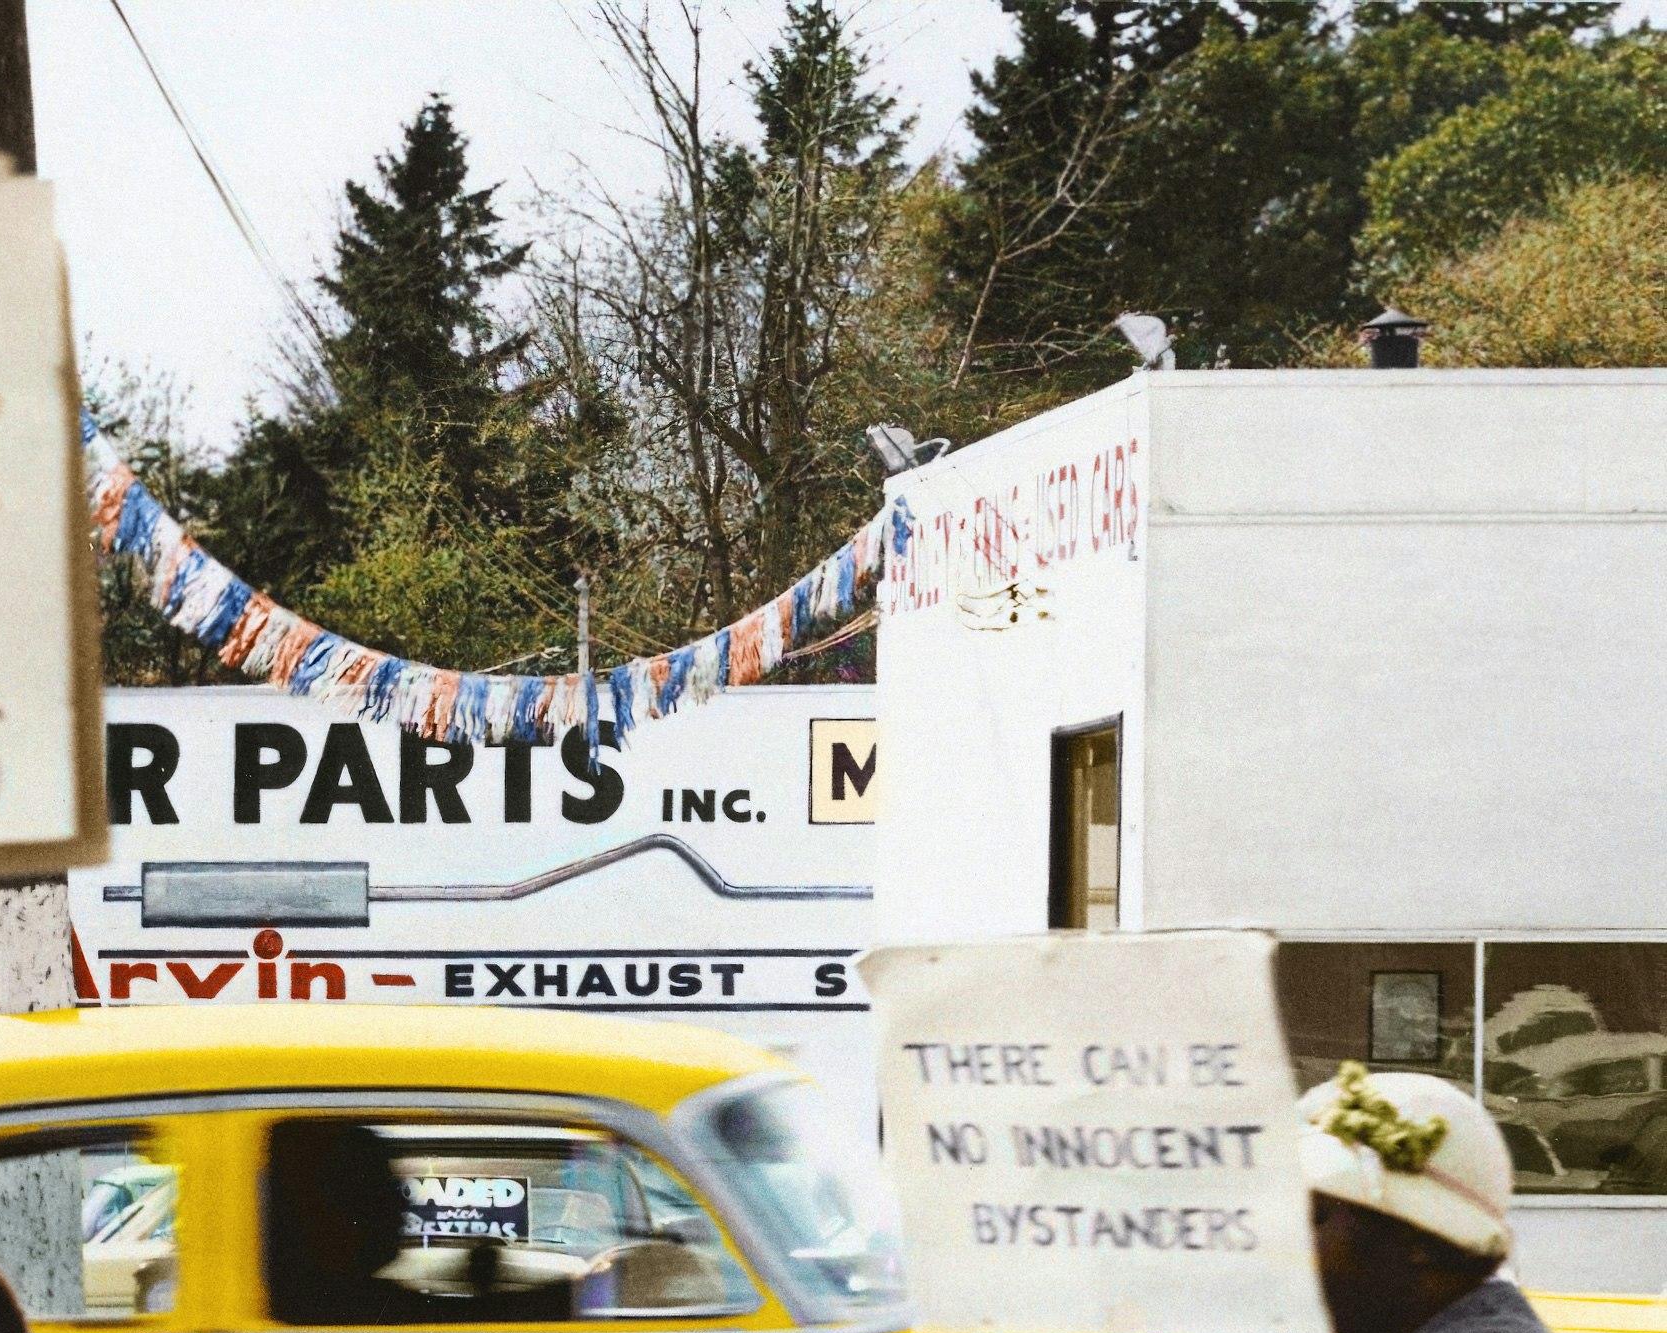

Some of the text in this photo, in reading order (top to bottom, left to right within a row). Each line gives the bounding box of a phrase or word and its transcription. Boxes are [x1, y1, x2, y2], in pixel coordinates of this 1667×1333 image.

[233, 722, 625, 826] PARTS
[662, 788, 767, 824] INC.
[444, 963, 745, 998] EXHAUST
[903, 1043, 1248, 1087] THERE CAN BE
[925, 1121, 1263, 1170] NO INNOCENT
[970, 1202, 1259, 1252] BYSTANDERS
